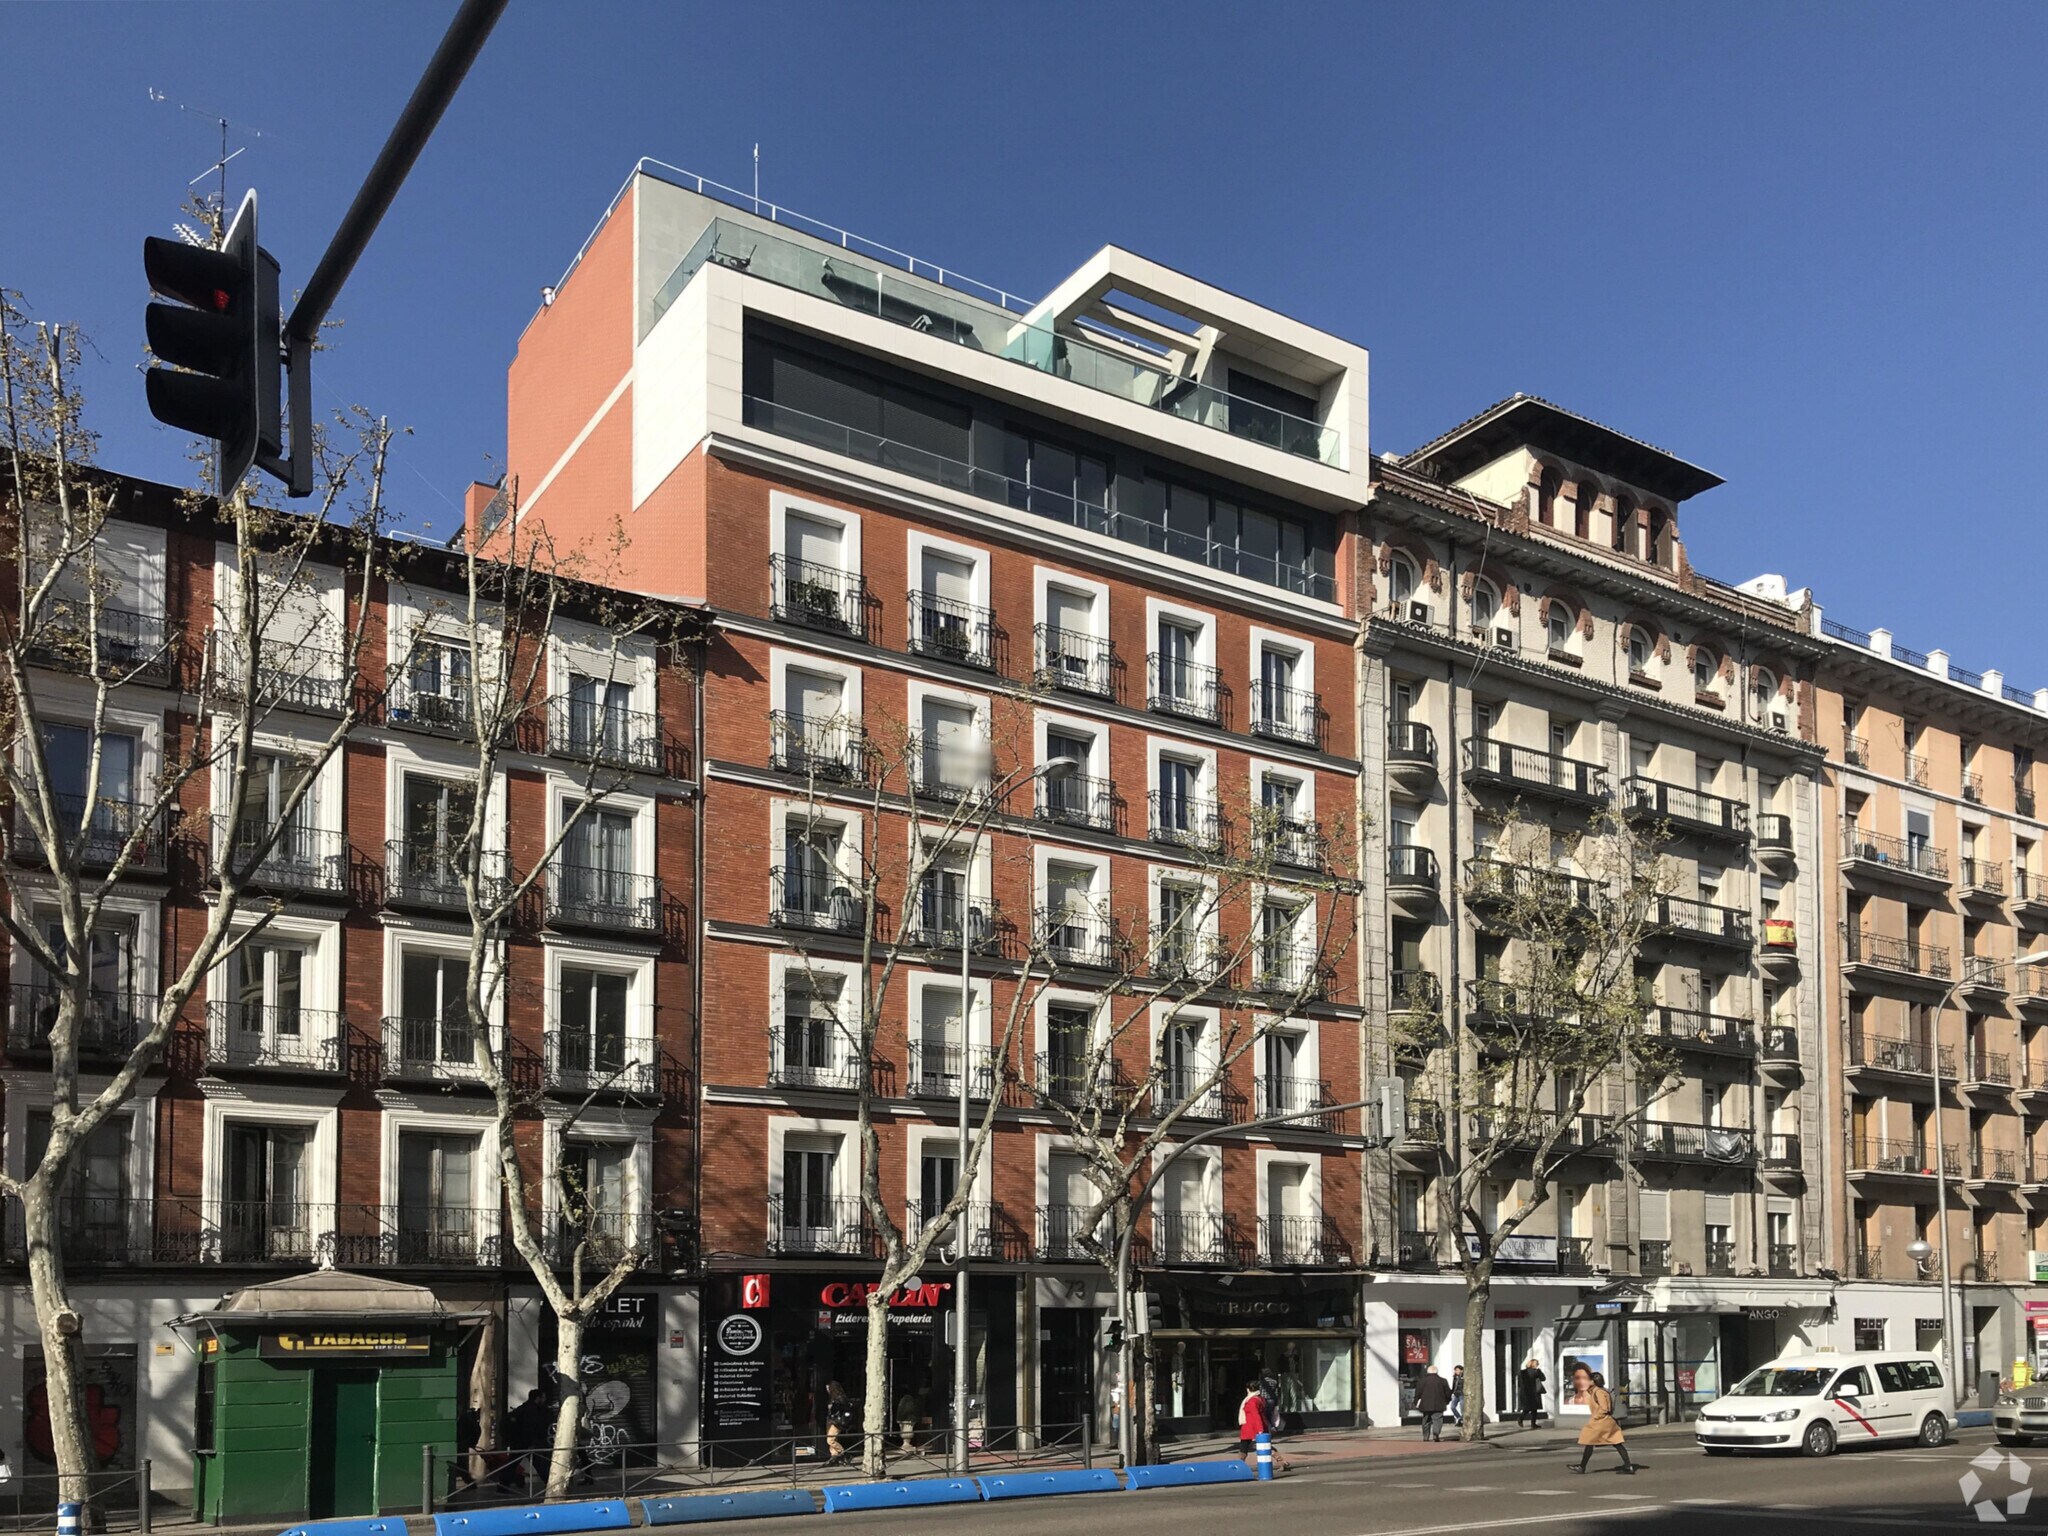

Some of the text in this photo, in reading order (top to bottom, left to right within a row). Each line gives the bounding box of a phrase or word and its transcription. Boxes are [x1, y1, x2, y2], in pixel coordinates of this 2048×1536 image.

[745, 1279, 760, 1305] C
[1065, 1281, 1086, 1301] 73
[1217, 1301, 1290, 1314] TRUCCO
[886, 1312, 932, 1326] Papelería
[1748, 1309, 1780, 1320] ANGO
[311, 1332, 407, 1345] TABACOS
[1405, 1338, 1427, 1349] SALE
